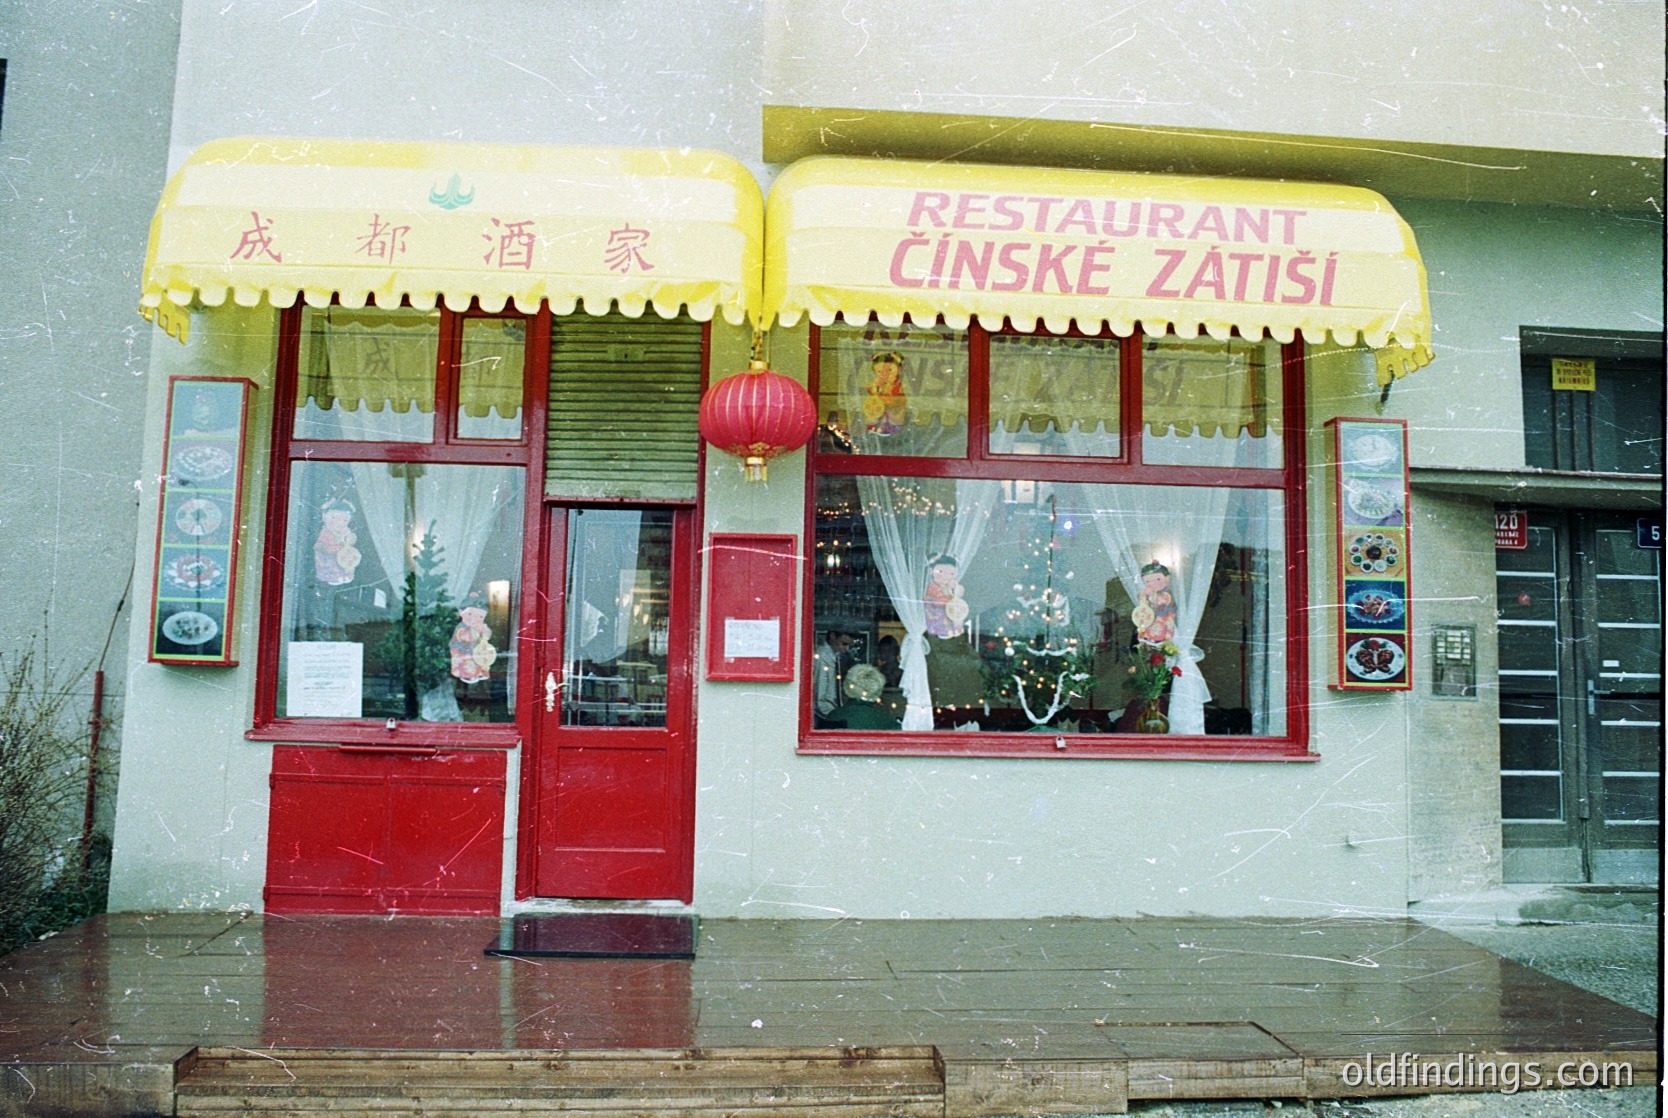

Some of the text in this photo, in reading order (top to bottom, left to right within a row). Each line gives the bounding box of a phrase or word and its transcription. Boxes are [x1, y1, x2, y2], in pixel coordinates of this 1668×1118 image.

[905, 190, 1307, 244] RESTAURANT
[890, 230, 1340, 306] ČÍNSKÉ ZÁTIŠÍ
